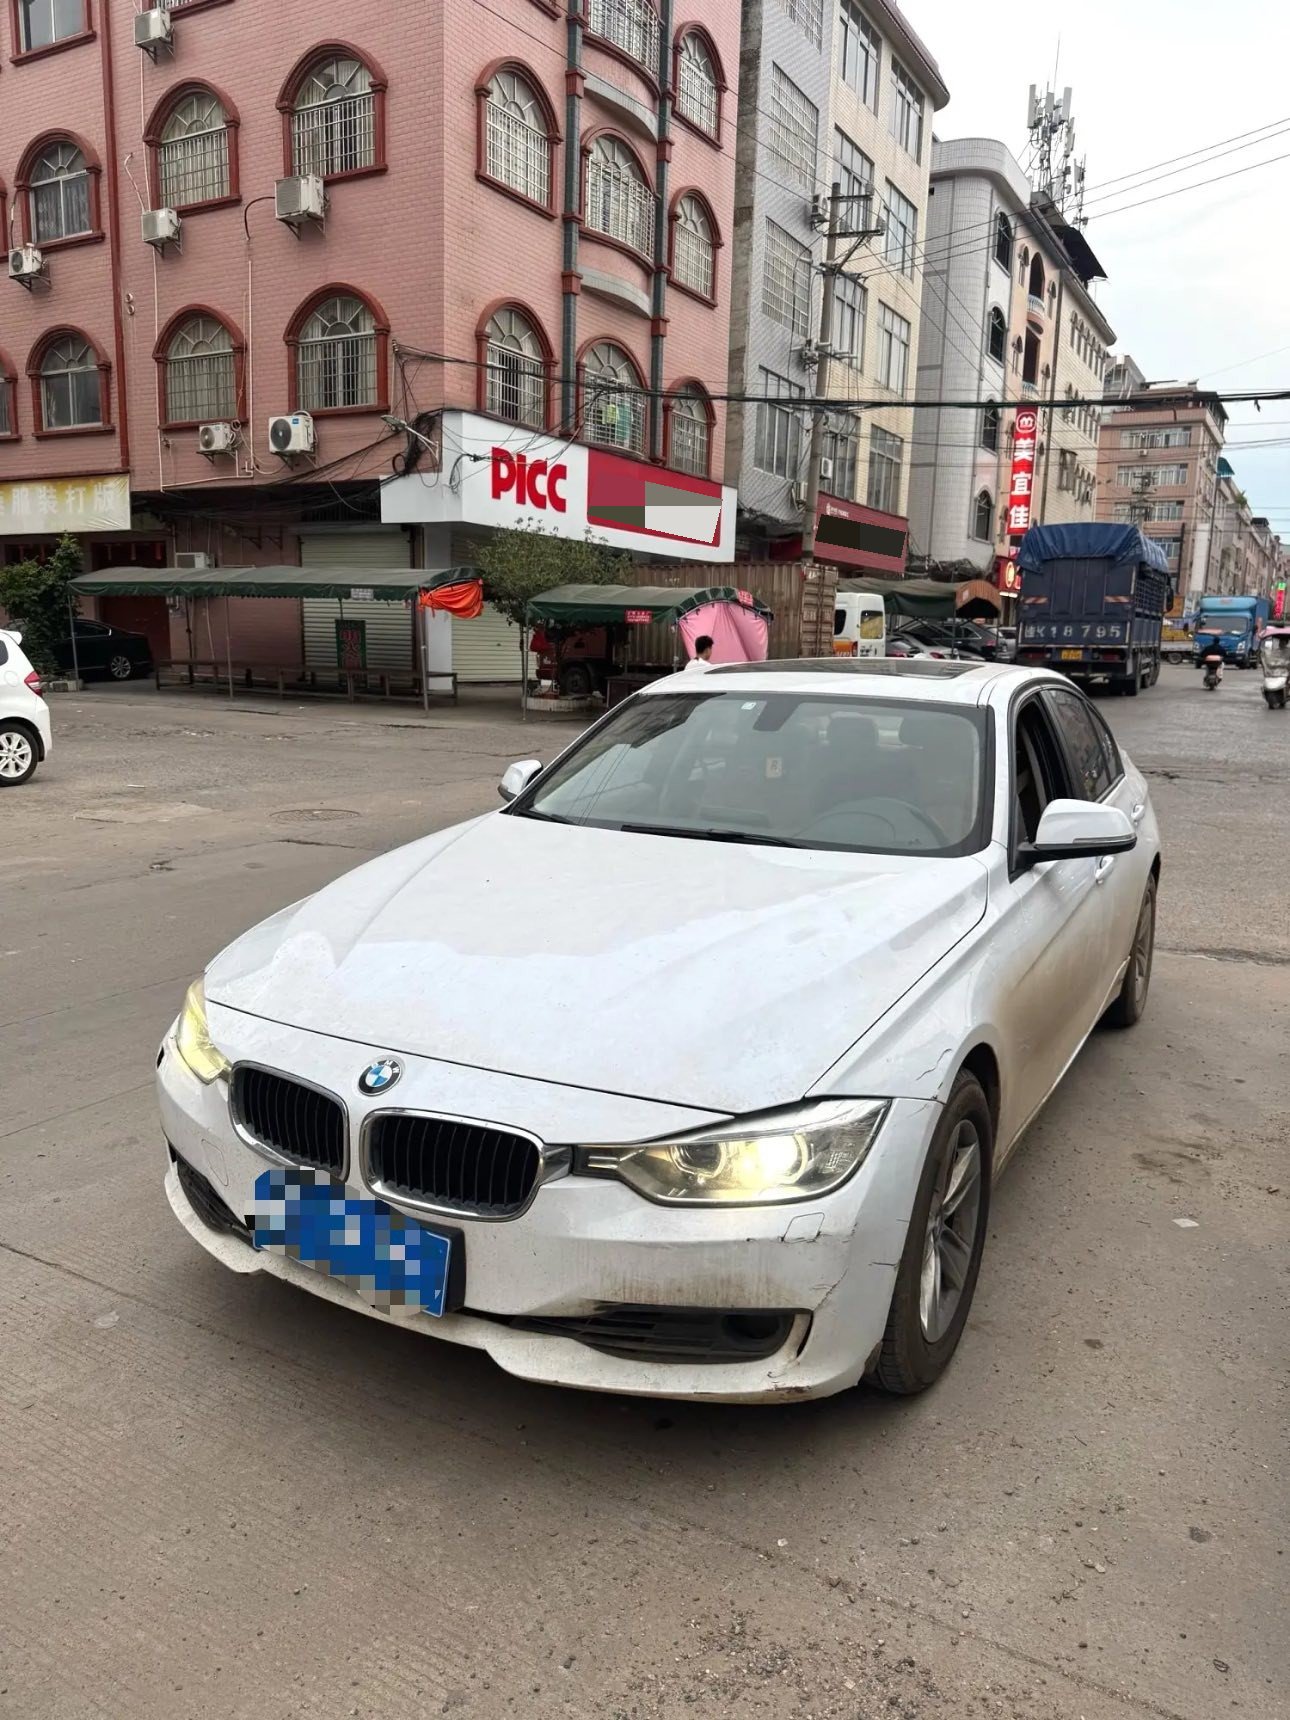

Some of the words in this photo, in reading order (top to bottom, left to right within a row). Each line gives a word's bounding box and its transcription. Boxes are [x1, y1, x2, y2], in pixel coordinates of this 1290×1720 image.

[0, 482, 119, 516] 服装打版
[491, 446, 567, 513] PICC
[1009, 437, 1036, 530] 美宜佳
